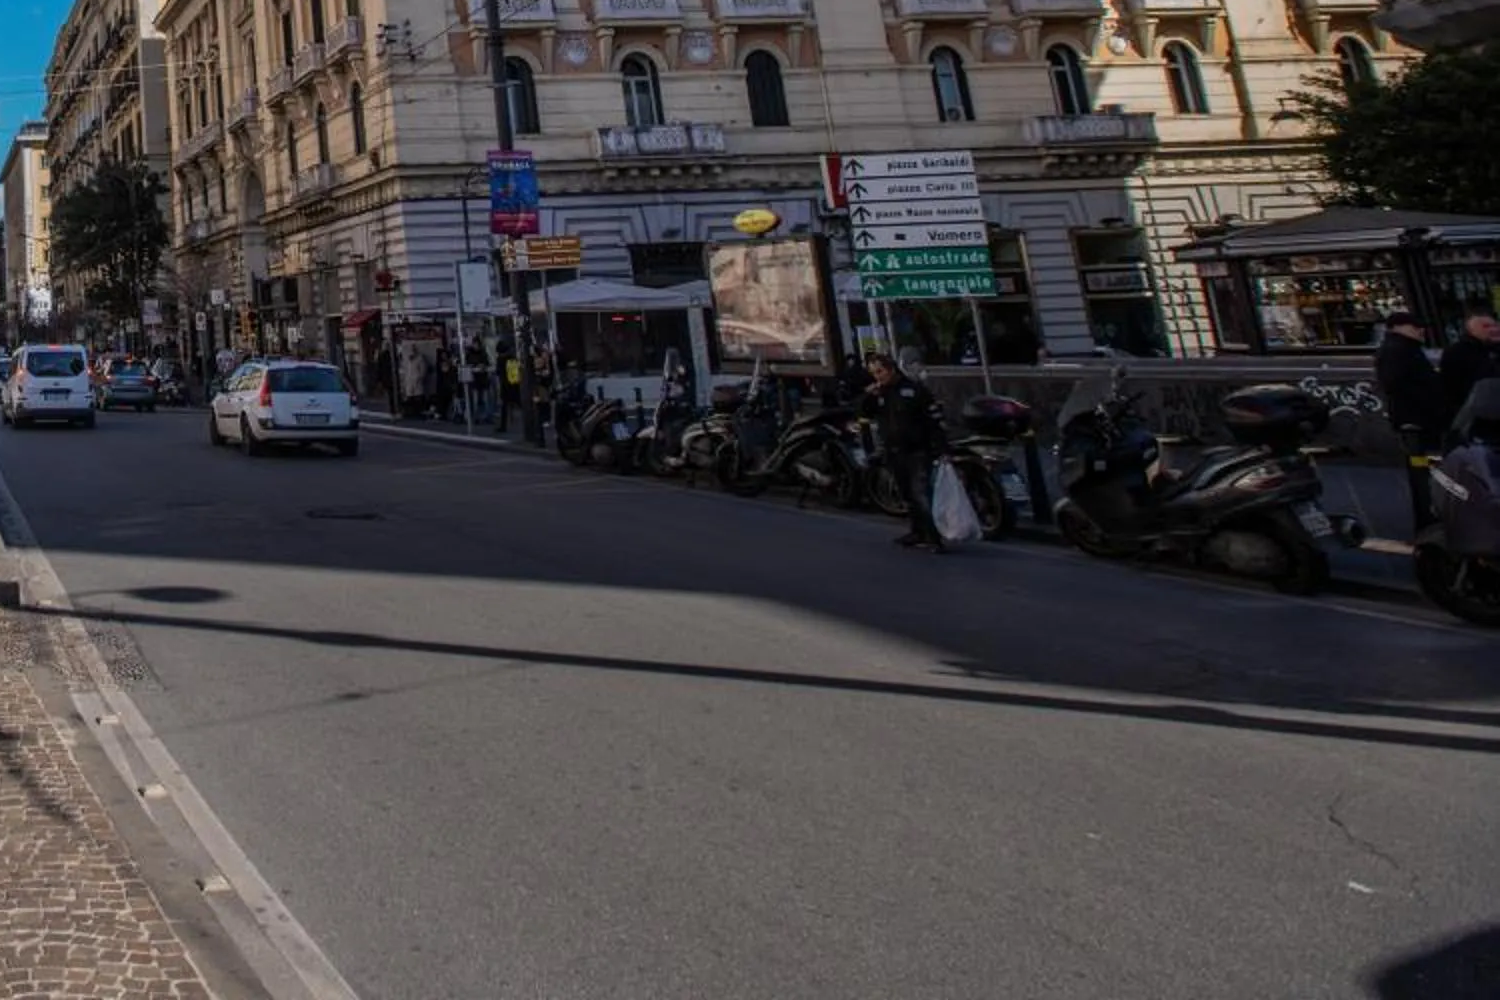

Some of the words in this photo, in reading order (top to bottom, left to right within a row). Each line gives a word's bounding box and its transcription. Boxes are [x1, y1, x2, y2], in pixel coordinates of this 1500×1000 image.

[887, 160, 918, 172] piazza
[922, 156, 969, 169] Garibaldi
[887, 184, 921, 195] piazza
[925, 182, 957, 192] Carlo
[927, 231, 982, 242] Vomero
[903, 275, 991, 293] tangenziale
